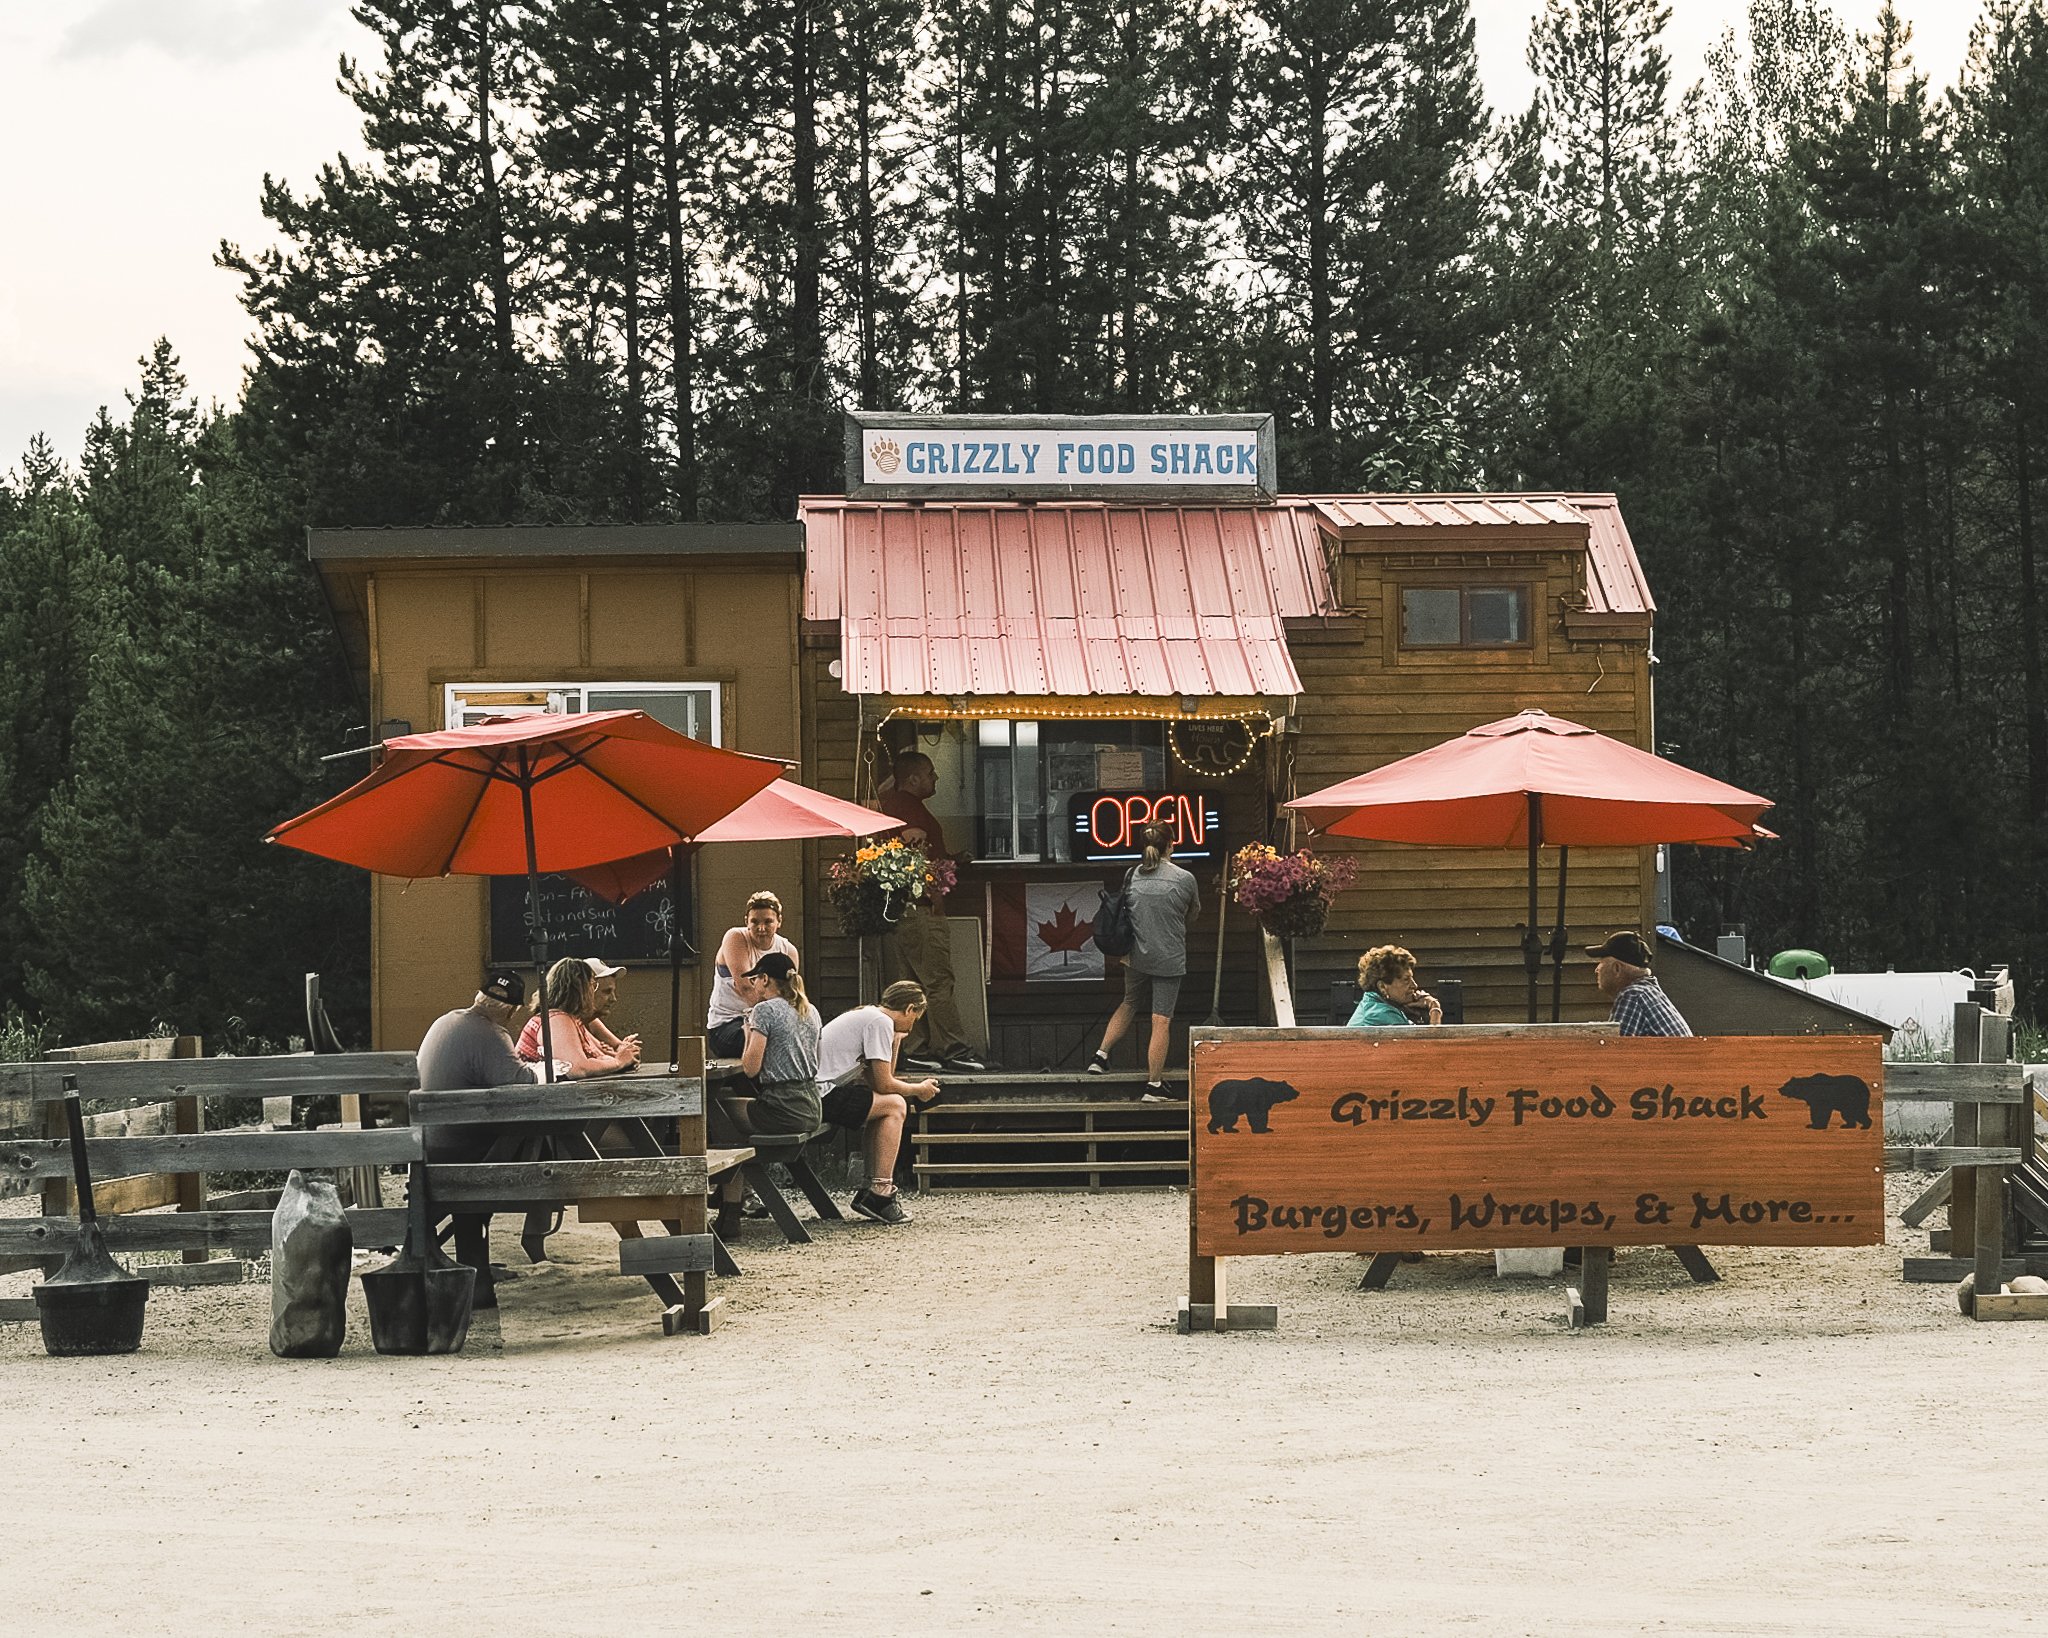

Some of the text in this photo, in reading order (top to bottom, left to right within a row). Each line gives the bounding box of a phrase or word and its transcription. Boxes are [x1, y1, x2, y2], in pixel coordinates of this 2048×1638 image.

[906, 442, 1257, 475] GRIZZLY FOOD SHACK
[1331, 1083, 1768, 1127] Grizzly Food Shack
[1230, 1192, 1855, 1238] Burgers, Wraps, & More...
